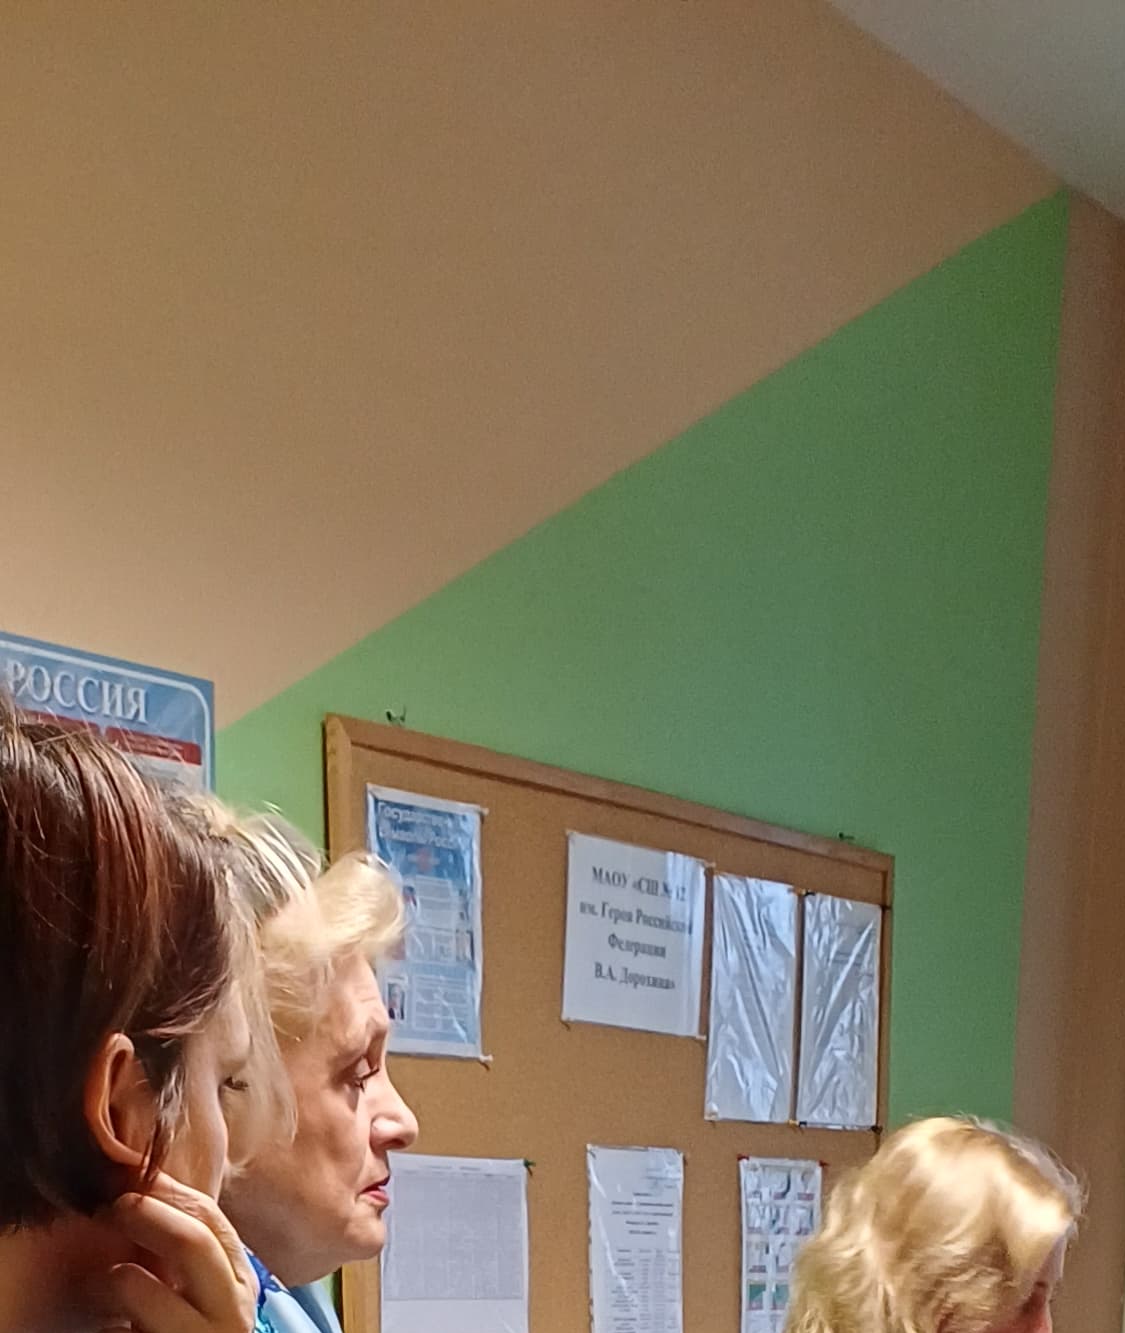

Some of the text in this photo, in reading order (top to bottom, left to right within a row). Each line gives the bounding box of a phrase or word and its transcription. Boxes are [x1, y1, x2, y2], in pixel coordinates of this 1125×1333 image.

[7, 660, 148, 724] РОССИЯ
[592, 866, 627, 888] МАОУ
[601, 902, 633, 924] Героя
[608, 933, 667, 958] Федерации
